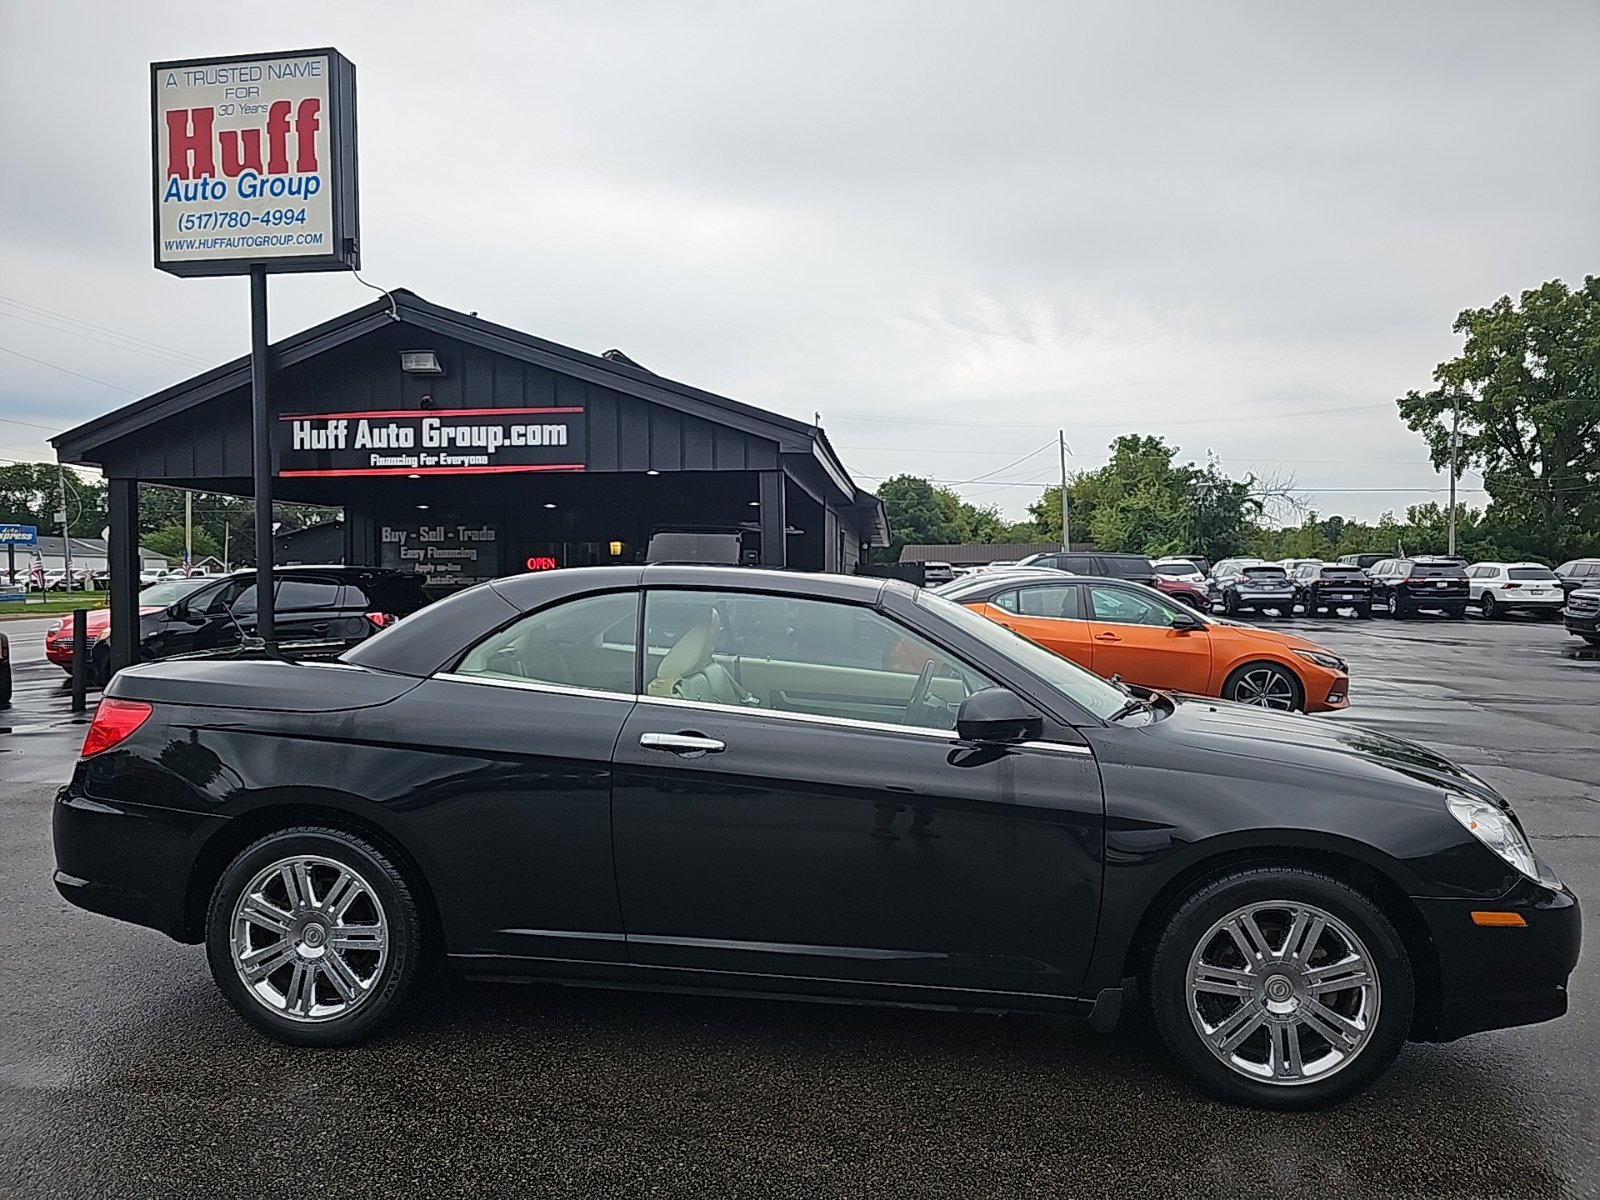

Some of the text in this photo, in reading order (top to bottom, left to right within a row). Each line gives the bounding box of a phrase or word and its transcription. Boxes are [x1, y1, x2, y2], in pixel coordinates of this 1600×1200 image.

[165, 61, 321, 88] A TRUSTED NAME
[225, 87, 260, 99] FOR
[218, 103, 268, 116] 30 Years
[166, 98, 320, 181] Huff
[163, 173, 320, 203] Auto Group
[178, 208, 306, 232] (517)780-4994
[164, 233, 323, 251] WWW.HUFFAUTOGROUP.COM
[293, 418, 568, 453] Huff Auto Group.com
[370, 452, 488, 467] Financing For Everyone
[381, 526, 407, 545] Buy
[419, 526, 444, 542] Sell
[457, 525, 496, 541] Trade
[400, 546, 477, 561] Easy Financing
[527, 557, 556, 570] OPEN
